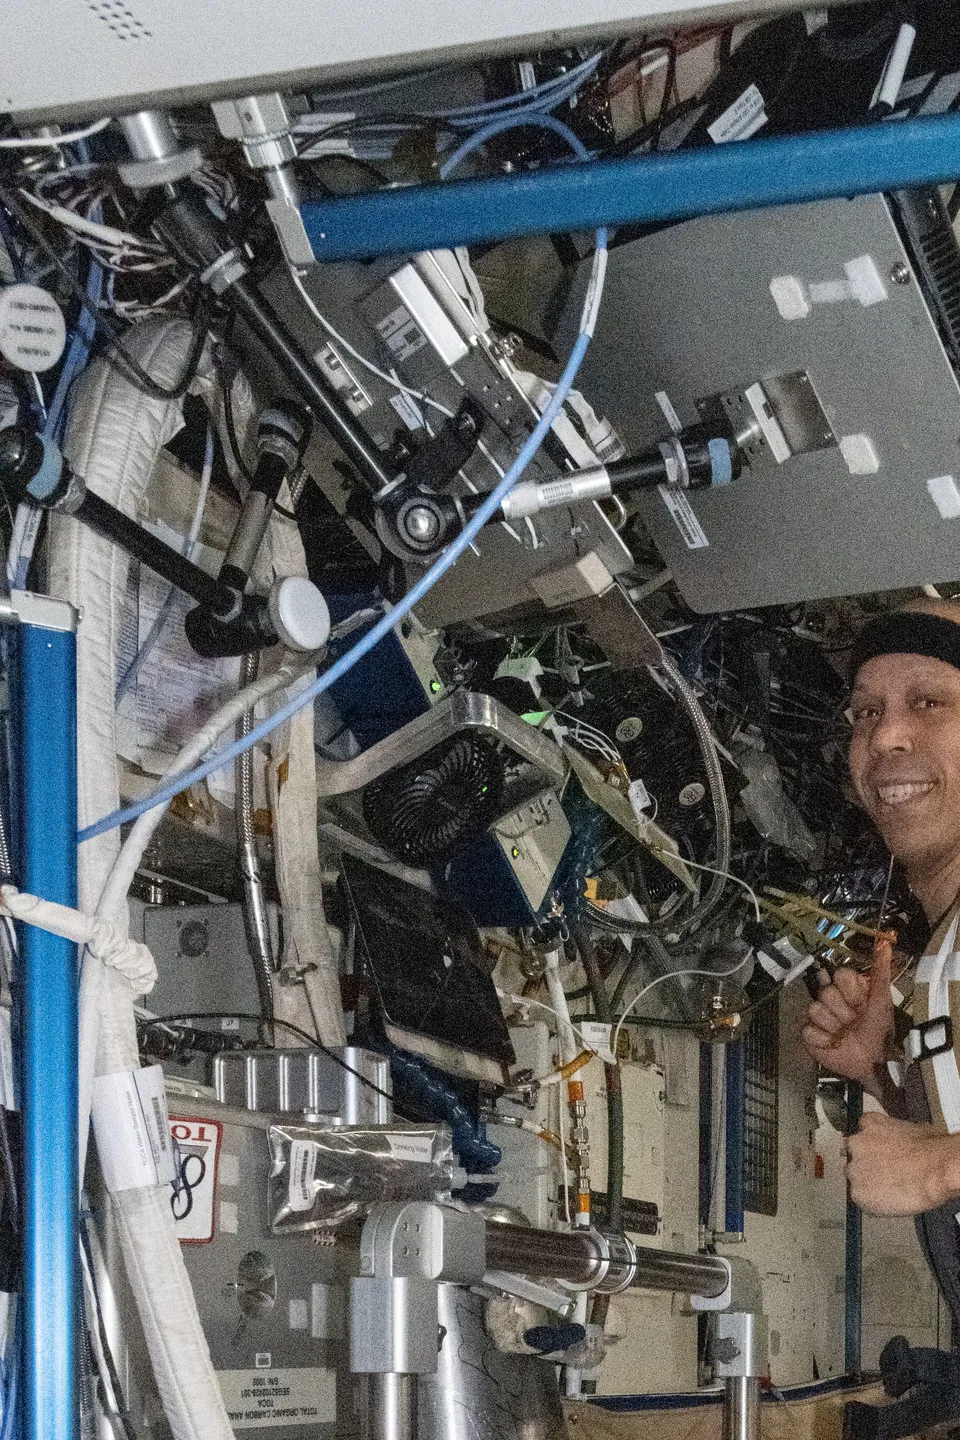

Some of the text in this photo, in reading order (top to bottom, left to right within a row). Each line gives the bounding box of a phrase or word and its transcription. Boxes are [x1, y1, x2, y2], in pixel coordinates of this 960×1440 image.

[171, 1124, 212, 1142] TO
[394, 1143, 428, 1153] Drinking Water
[258, 1399, 274, 1407] TOCA
[227, 1407, 318, 1420] TOTAL ORGANIC CARBON ANAL
